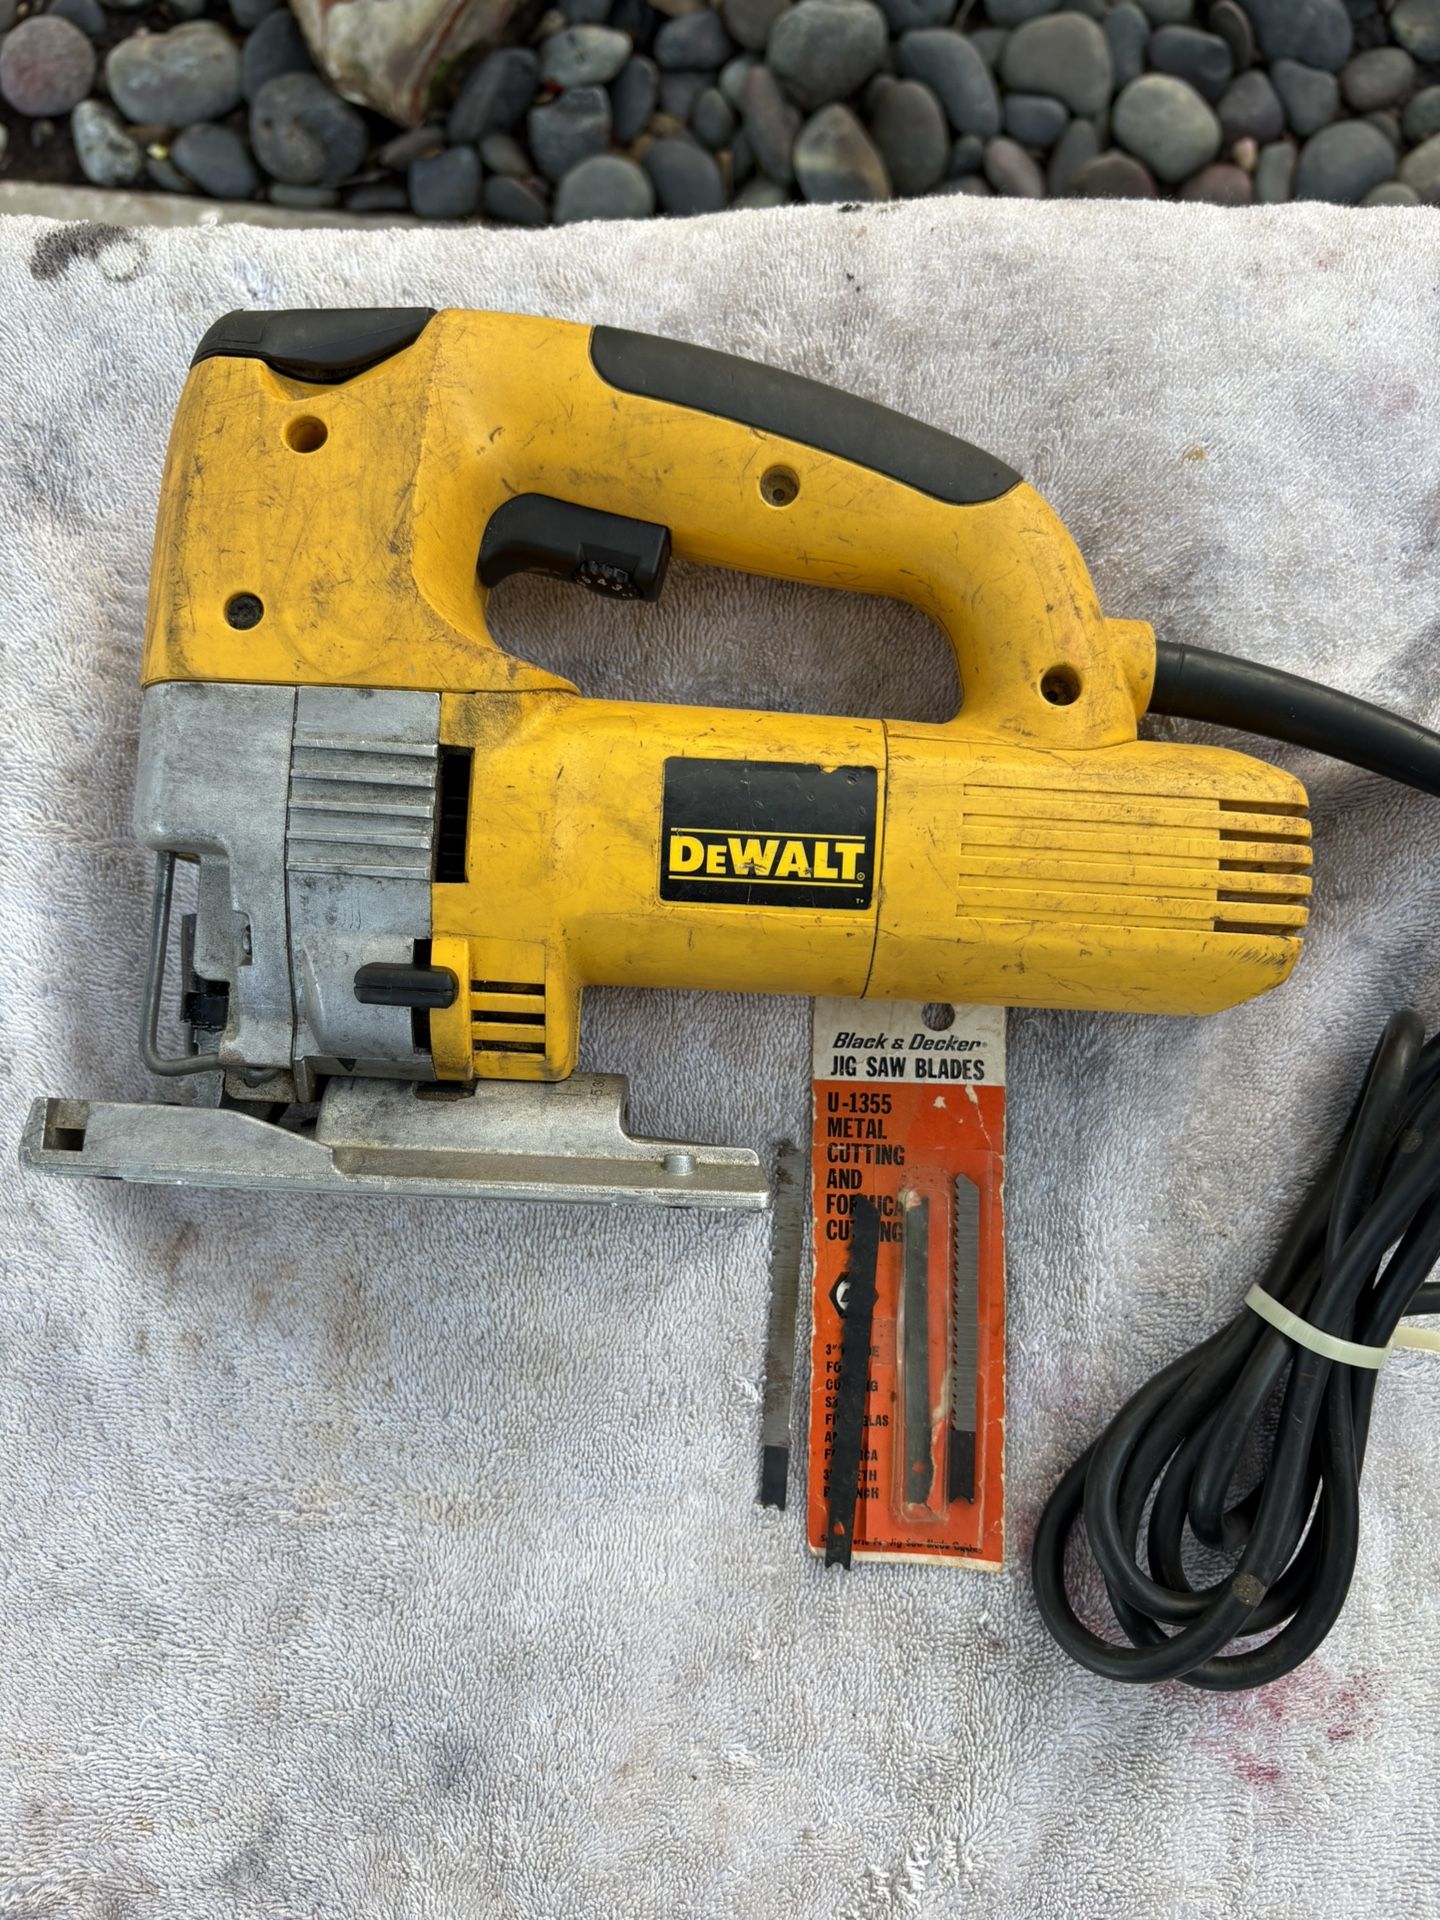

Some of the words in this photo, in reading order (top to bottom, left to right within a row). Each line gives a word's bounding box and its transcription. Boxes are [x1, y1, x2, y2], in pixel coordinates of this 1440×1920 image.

[832, 1031, 888, 1050] Black
[891, 1037, 905, 1050] &
[908, 1032, 982, 1052] Decker
[830, 1054, 857, 1076] JIG
[866, 1056, 907, 1078] SAW
[914, 1057, 985, 1081] BLADES
[827, 1091, 892, 1115] U-1355
[827, 1117, 887, 1140] METAL
[827, 1142, 905, 1166] CUTTING
[826, 1168, 863, 1190] AND
[826, 1219, 904, 1242] CUNG
